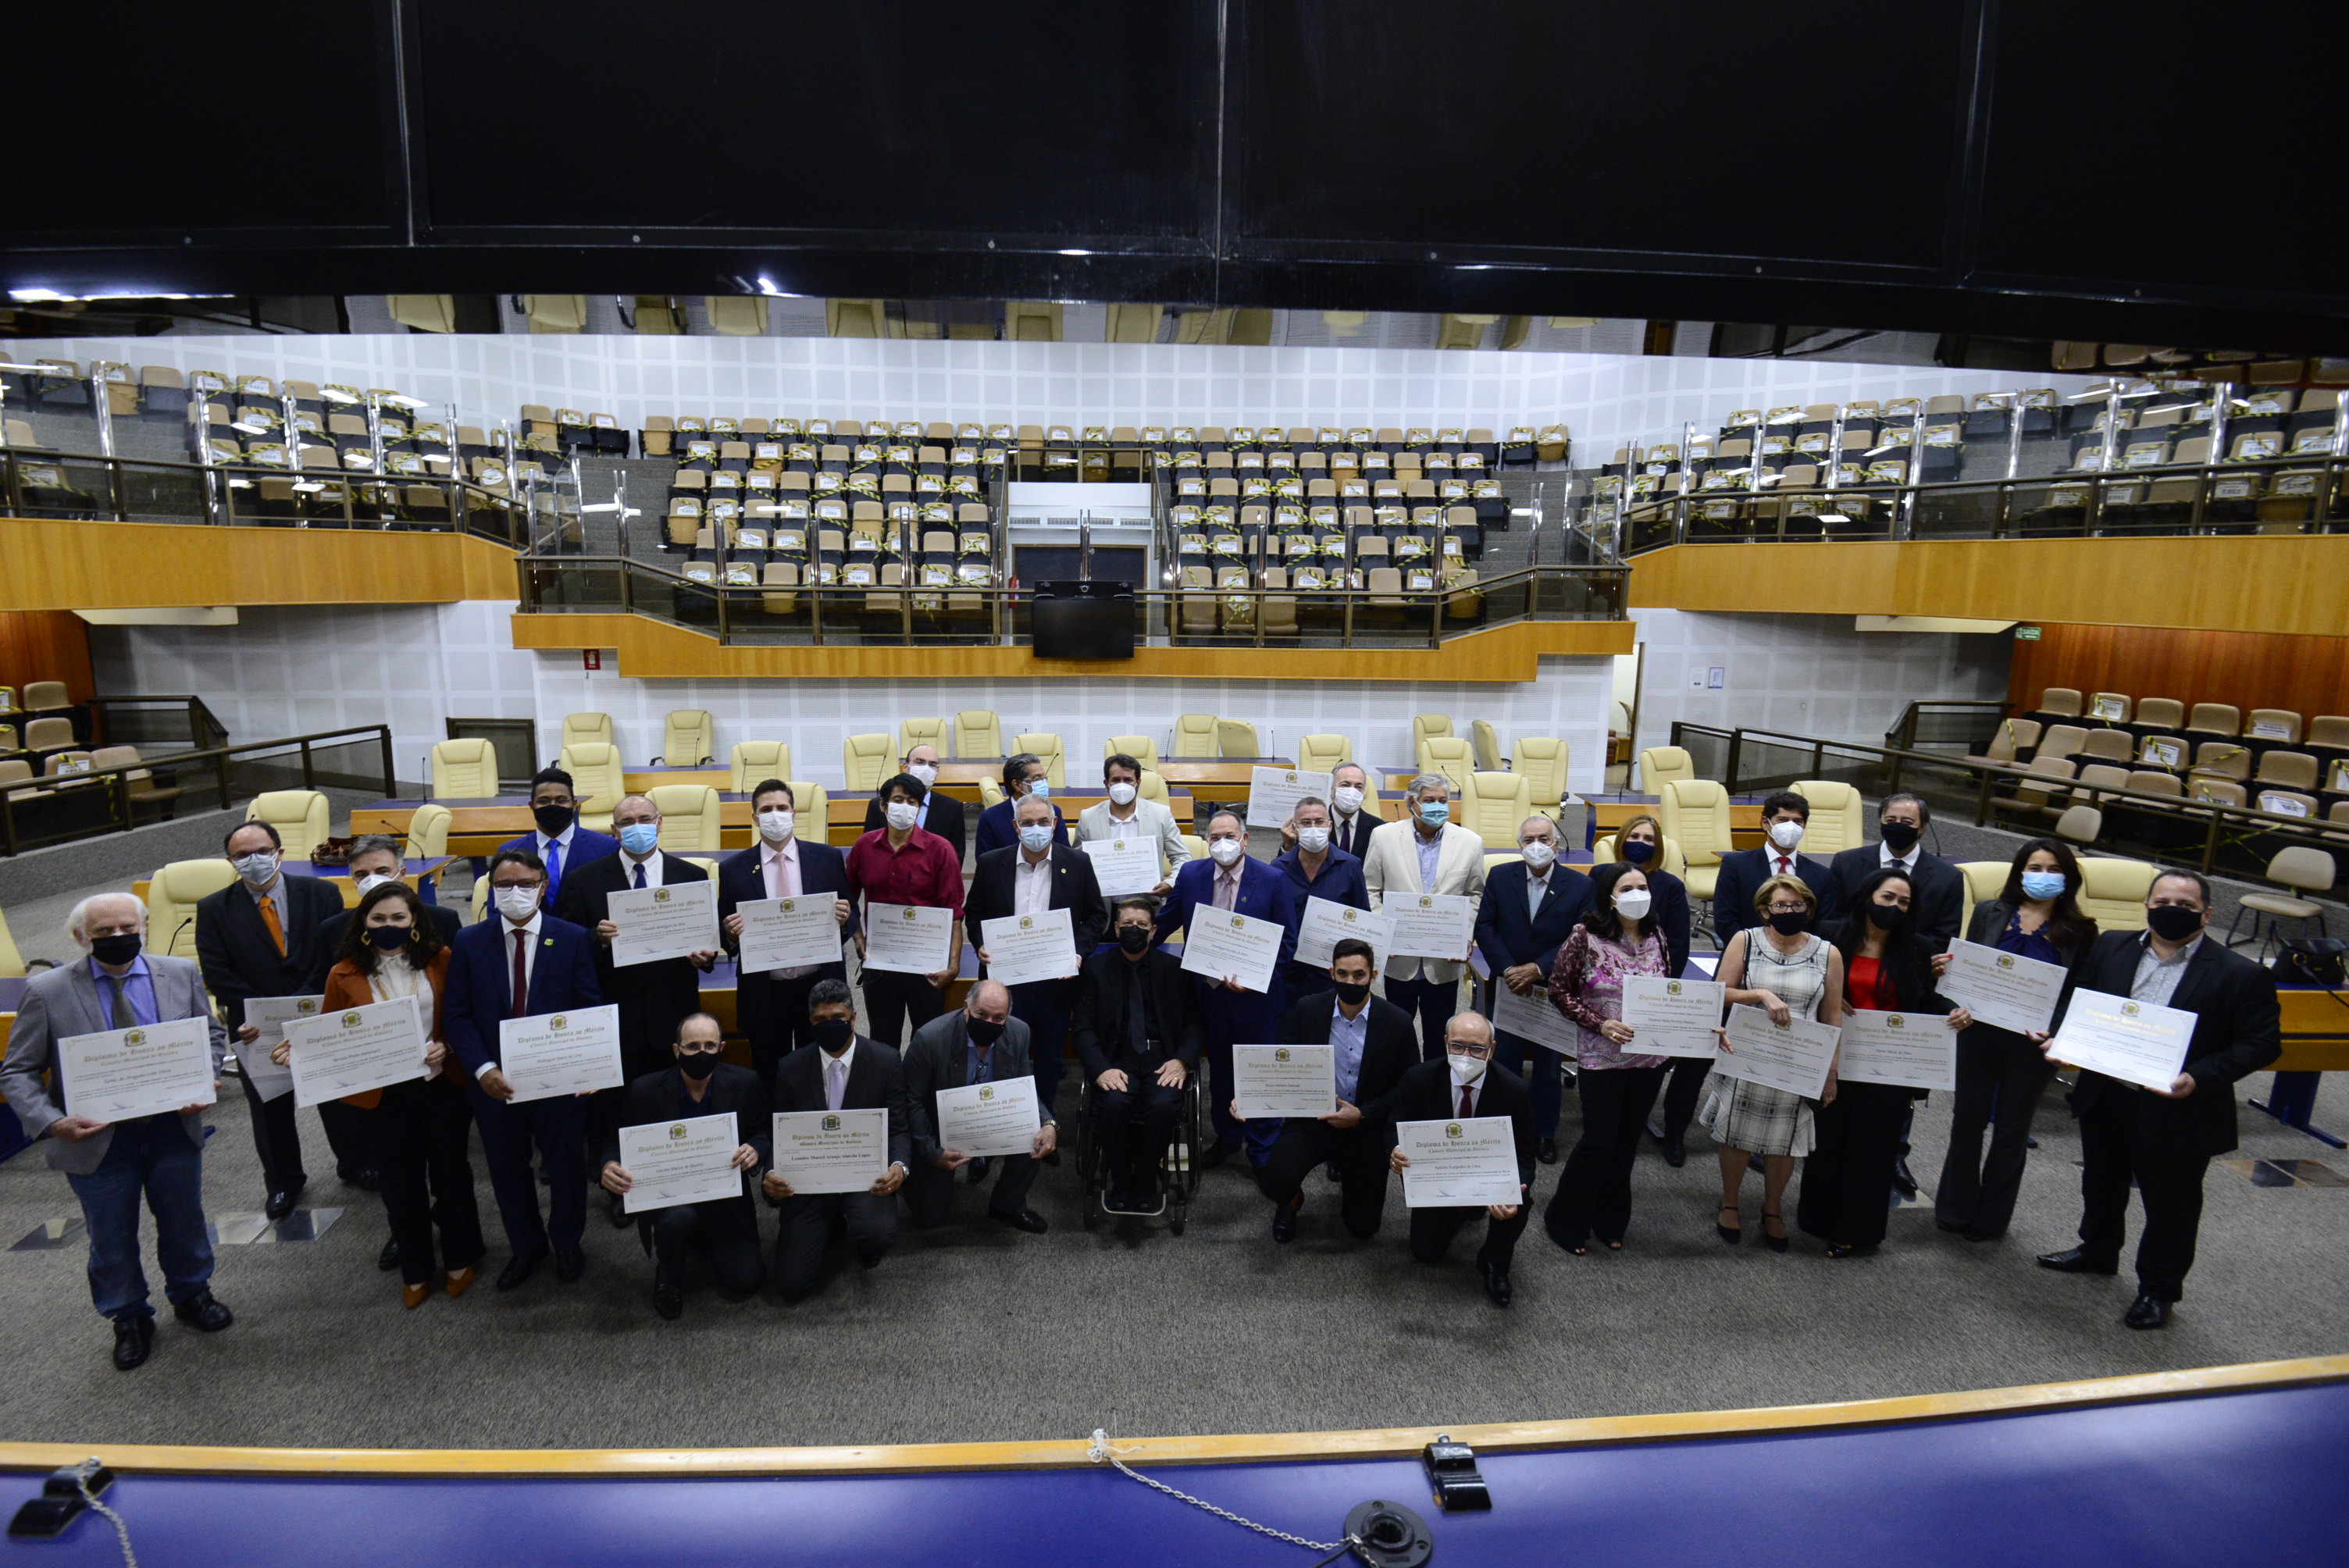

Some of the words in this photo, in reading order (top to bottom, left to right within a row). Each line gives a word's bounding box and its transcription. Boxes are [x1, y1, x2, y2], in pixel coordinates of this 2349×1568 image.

[517, 1035, 544, 1044] Diploma
[583, 1025, 604, 1034] Mérito
[638, 1145, 665, 1153] Diploma
